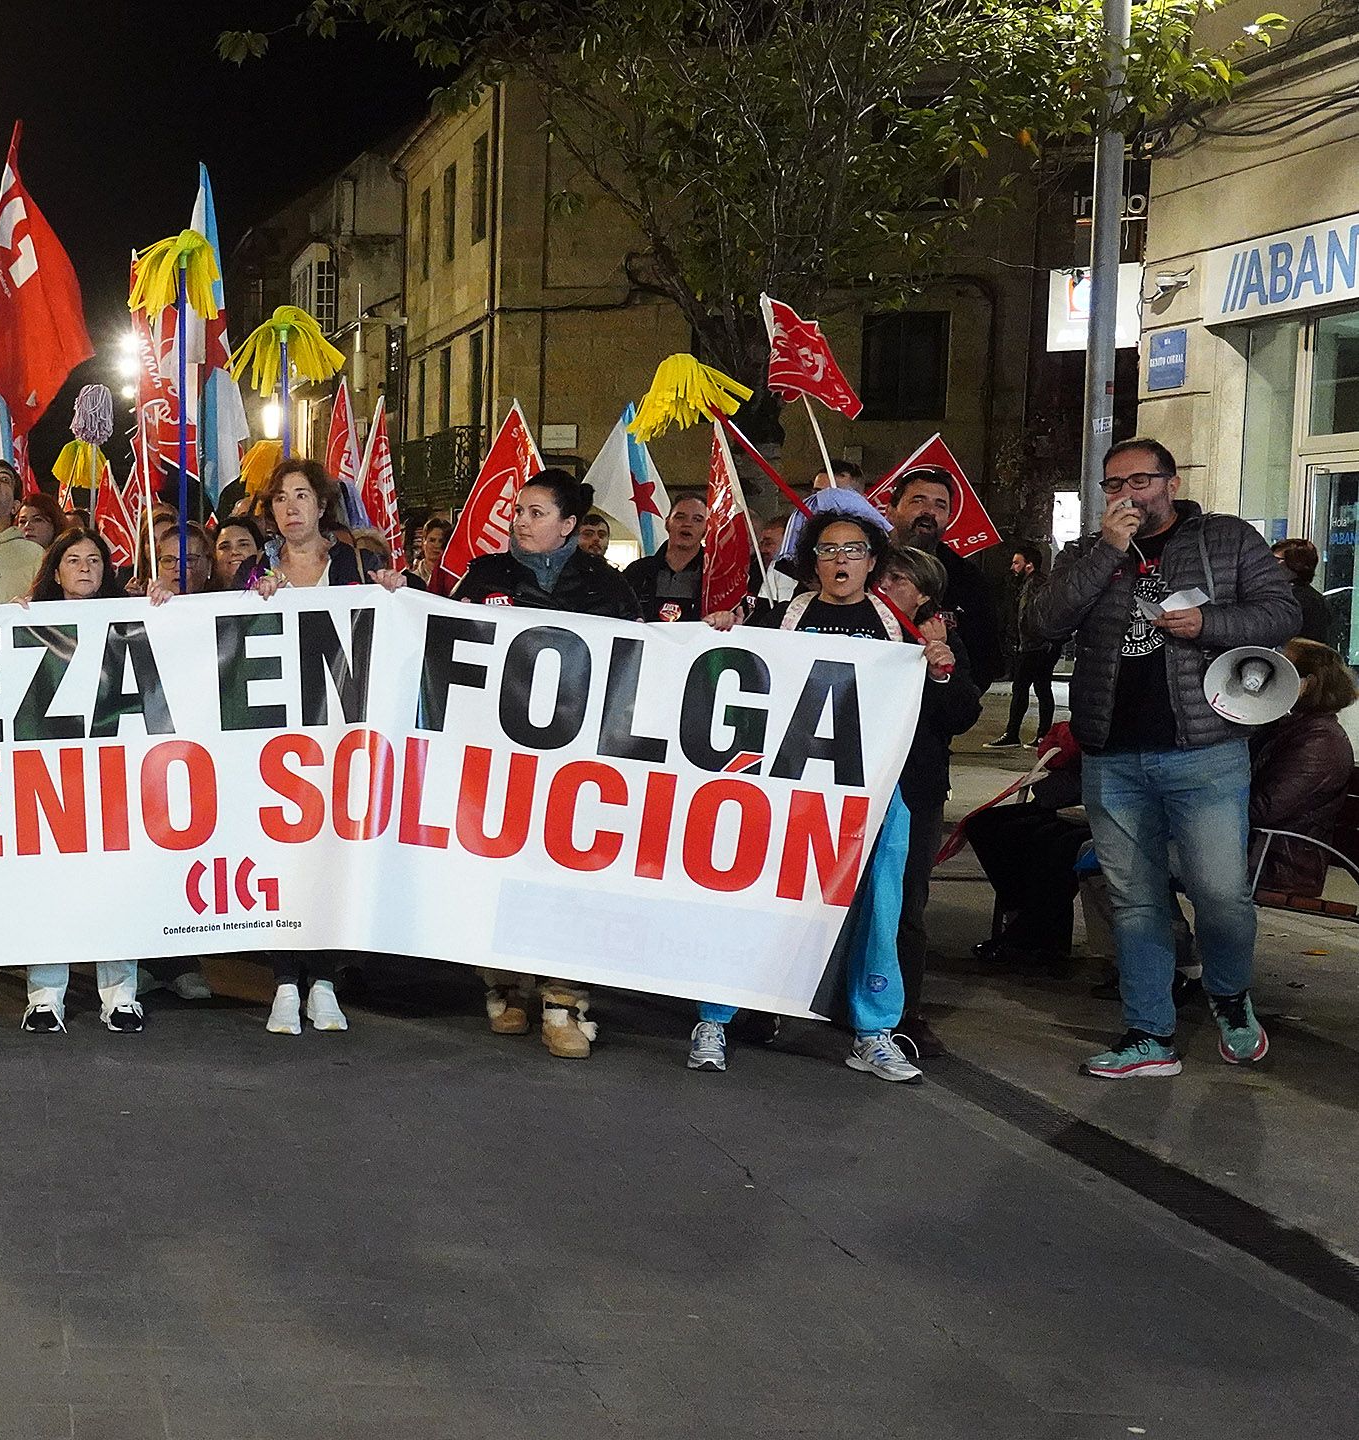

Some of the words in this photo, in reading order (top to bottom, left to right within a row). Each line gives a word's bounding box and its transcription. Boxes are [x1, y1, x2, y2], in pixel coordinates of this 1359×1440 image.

[217, 608, 375, 731] EN
[416, 614, 866, 787] FOLGA
[259, 728, 870, 906] SOLUCIÓN
[163, 924, 221, 935] Confederación
[222, 920, 274, 931] Intersindical
[275, 920, 302, 930] Galega
[186, 856, 280, 915] CIG
